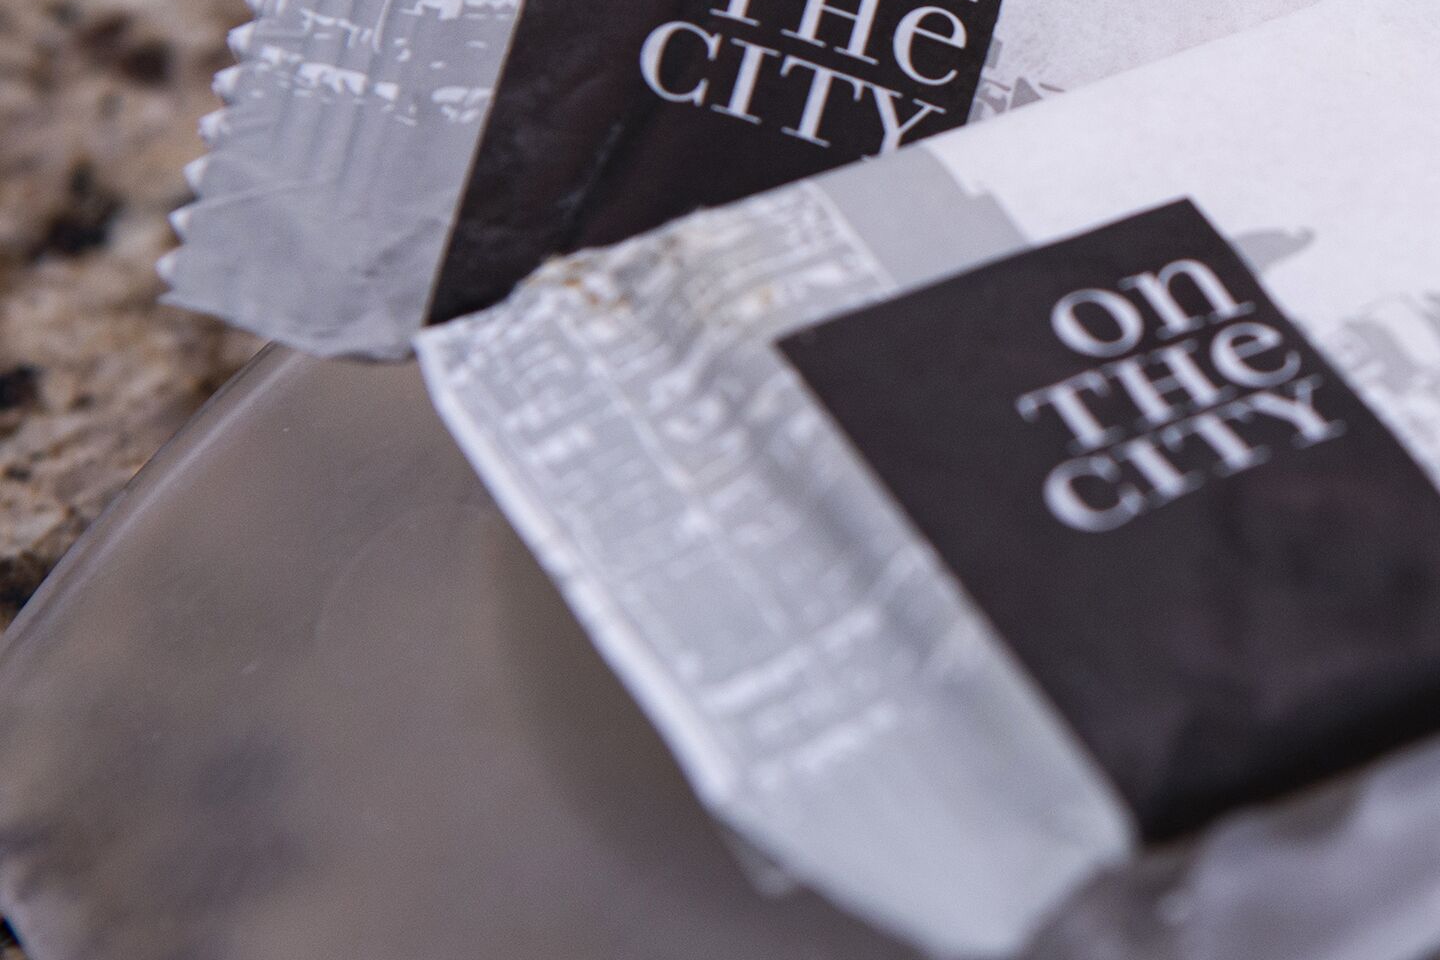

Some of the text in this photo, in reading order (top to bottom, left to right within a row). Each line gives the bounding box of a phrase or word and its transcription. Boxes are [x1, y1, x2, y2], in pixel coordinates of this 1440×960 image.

[640, 20, 947, 162] CITY
[1049, 257, 1256, 359] on
[1015, 321, 1301, 456] THe
[1041, 374, 1348, 533] CITY
